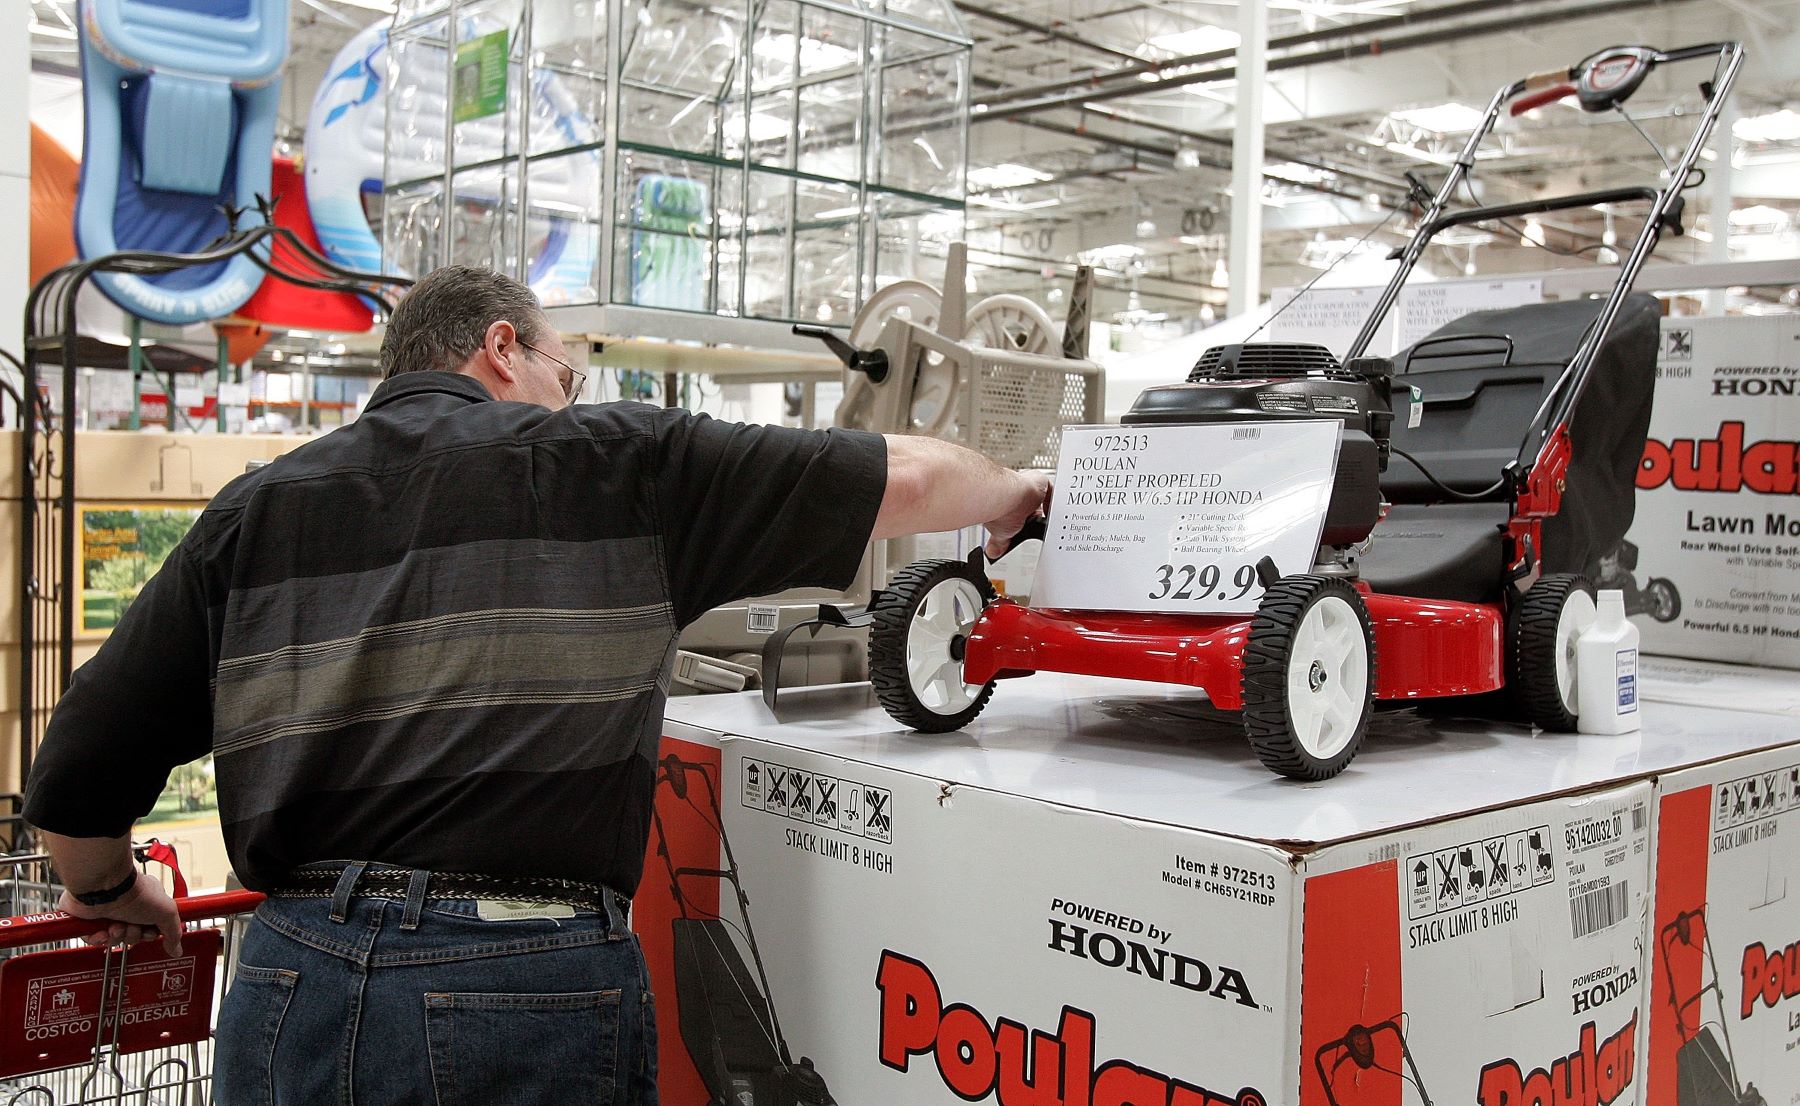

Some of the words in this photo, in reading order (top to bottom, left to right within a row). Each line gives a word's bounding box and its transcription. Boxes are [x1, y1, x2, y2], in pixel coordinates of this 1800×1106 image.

[1665, 366, 1692, 378] HIGH
[1714, 367, 1780, 376] POWERED
[1783, 367, 1798, 376] by
[1711, 379, 1800, 396] HON
[1094, 435, 1149, 451] 972513
[1073, 456, 1137, 470] POULAN
[1635, 420, 1800, 496] oula
[1070, 474, 1092, 489] 21"
[1096, 474, 1134, 489] SELF
[1137, 473, 1222, 488] PROPELED
[1067, 491, 1127, 506] MOWER
[1133, 490, 1172, 506] W/6.5
[1177, 490, 1199, 505] HP
[1201, 490, 1263, 505] HONDA
[1071, 513, 1100, 521] Powerful
[1112, 513, 1123, 521] HP
[1123, 513, 1145, 521] Honda
[1201, 513, 1226, 522] Cutting
[1686, 510, 1754, 534] Lawn
[1070, 523, 1092, 533] Engine
[1186, 524, 1215, 532] Variable
[1132, 534, 1146, 543] Bag
[1066, 544, 1077, 552] and
[1077, 544, 1092, 552] Side
[1092, 544, 1124, 553] Discharge
[1196, 545, 1222, 554] Bearing
[1224, 545, 1248, 553] Wheel
[1680, 541, 1704, 551] Rear
[1708, 542, 1740, 553] Wheel
[1744, 544, 1771, 555] Drive
[1683, 620, 1729, 633] Powerful
[1732, 624, 1749, 634] 6.5
[1752, 625, 1768, 636] HP
[1712, 833, 1733, 855] STACK
[1735, 826, 1753, 848] LIMIT
[1754, 824, 1759, 841] 8
[1760, 820, 1777, 840] HIGH
[786, 828, 817, 853] STACK
[820, 837, 849, 862] LIMIT
[852, 846, 859, 865] 8
[863, 848, 893, 874] HIGH
[1175, 854, 1206, 875] Item
[1210, 861, 1219, 877] #
[1223, 864, 1276, 890] 972513
[1416, 870, 1426, 883] UP
[1162, 870, 1192, 888] Model
[1194, 877, 1201, 890] #
[1204, 879, 1276, 907] CH65Y21RDP
[1050, 897, 1144, 934] POWERED
[1147, 924, 1172, 944] by
[1409, 918, 1446, 949] STACK
[1448, 909, 1478, 938] LIMIT
[1481, 907, 1489, 928] 8
[1491, 899, 1519, 926] HIGH
[1048, 918, 1260, 1010] HONDA
[1572, 966, 1613, 989] POWERED
[1612, 964, 1620, 974] by
[1571, 966, 1638, 1016] HONDA
[27, 989, 40, 1027] WARNING
[25, 1020, 92, 1041] COSTCO
